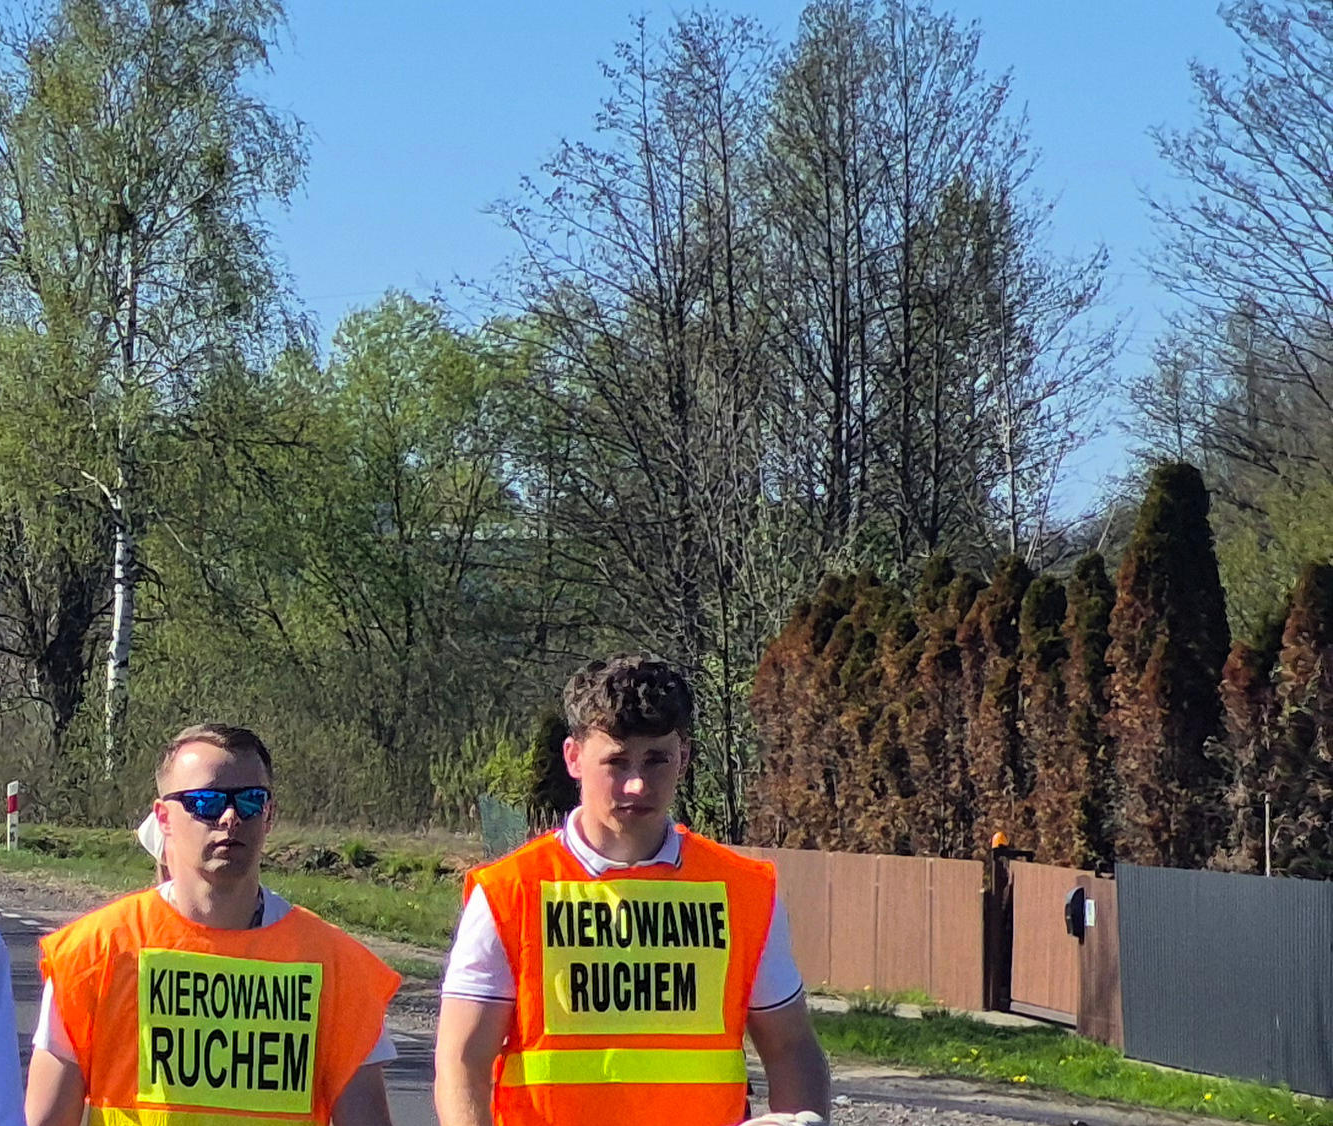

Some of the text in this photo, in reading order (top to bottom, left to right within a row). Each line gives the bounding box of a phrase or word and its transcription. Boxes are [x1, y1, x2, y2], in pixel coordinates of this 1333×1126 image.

[545, 899, 727, 950] KIEROWANIE
[149, 967, 313, 1022] KIEROWANIE
[570, 961, 697, 1013] RUCHEM
[151, 1026, 310, 1093] RUCHEM
